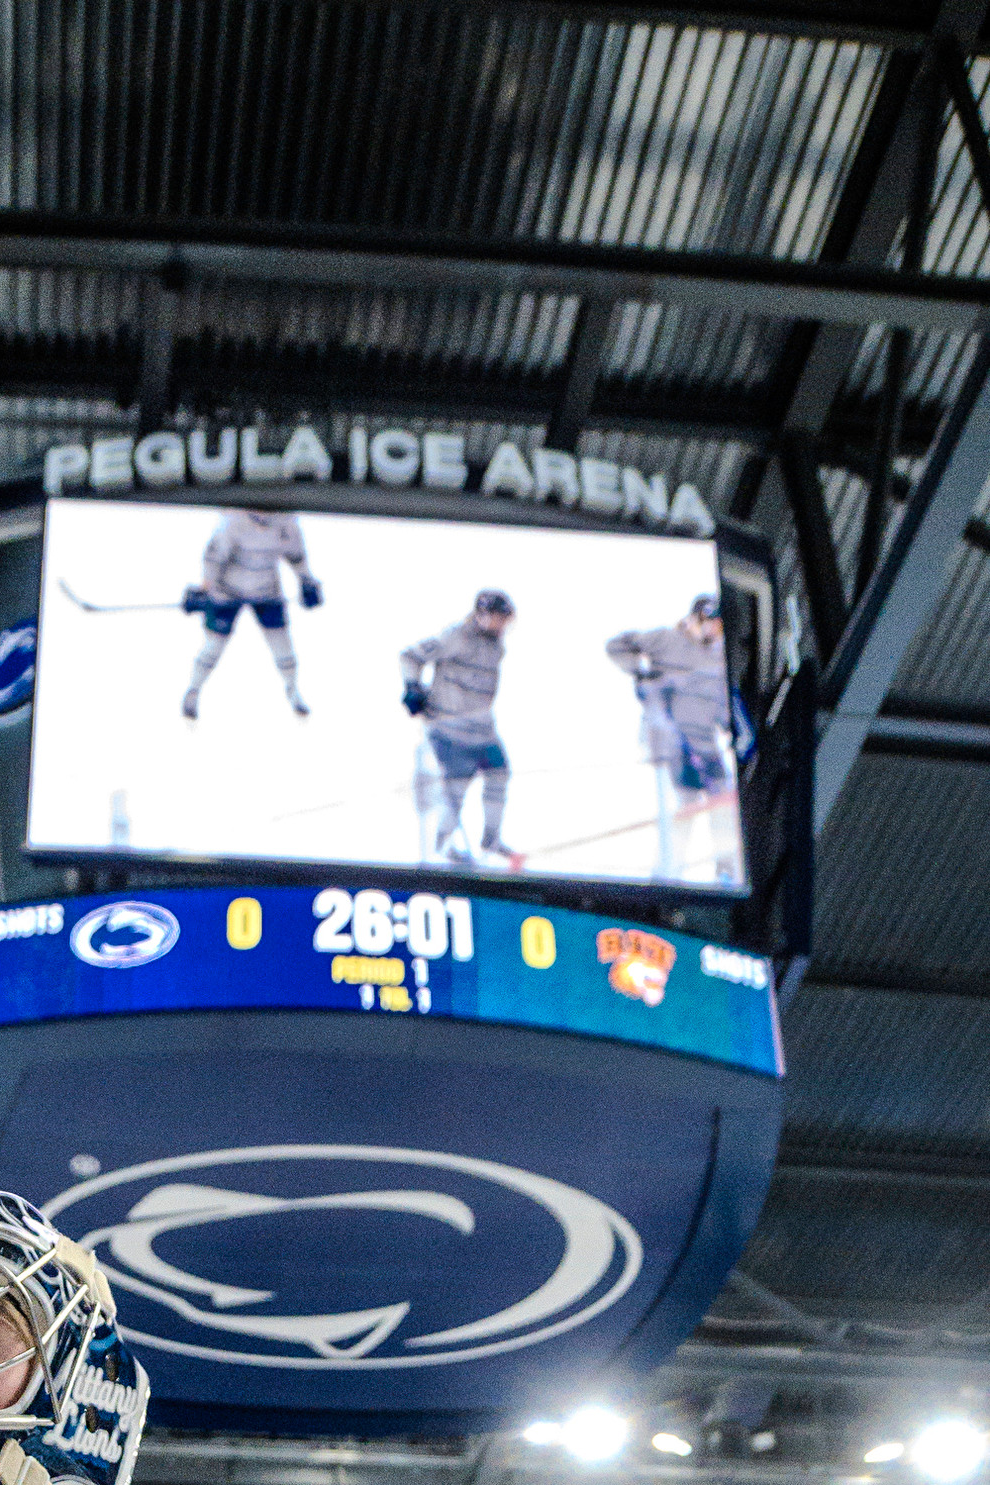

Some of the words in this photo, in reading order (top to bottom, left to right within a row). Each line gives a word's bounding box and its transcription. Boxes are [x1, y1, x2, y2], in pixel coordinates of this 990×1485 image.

[44, 427, 332, 496] PEGULA
[348, 426, 467, 489] ICE
[483, 441, 715, 538] ARENA
[227, 897, 262, 950] 0
[313, 888, 474, 962] 26:01
[520, 916, 556, 969] 0
[699, 945, 767, 990] SHOTS
